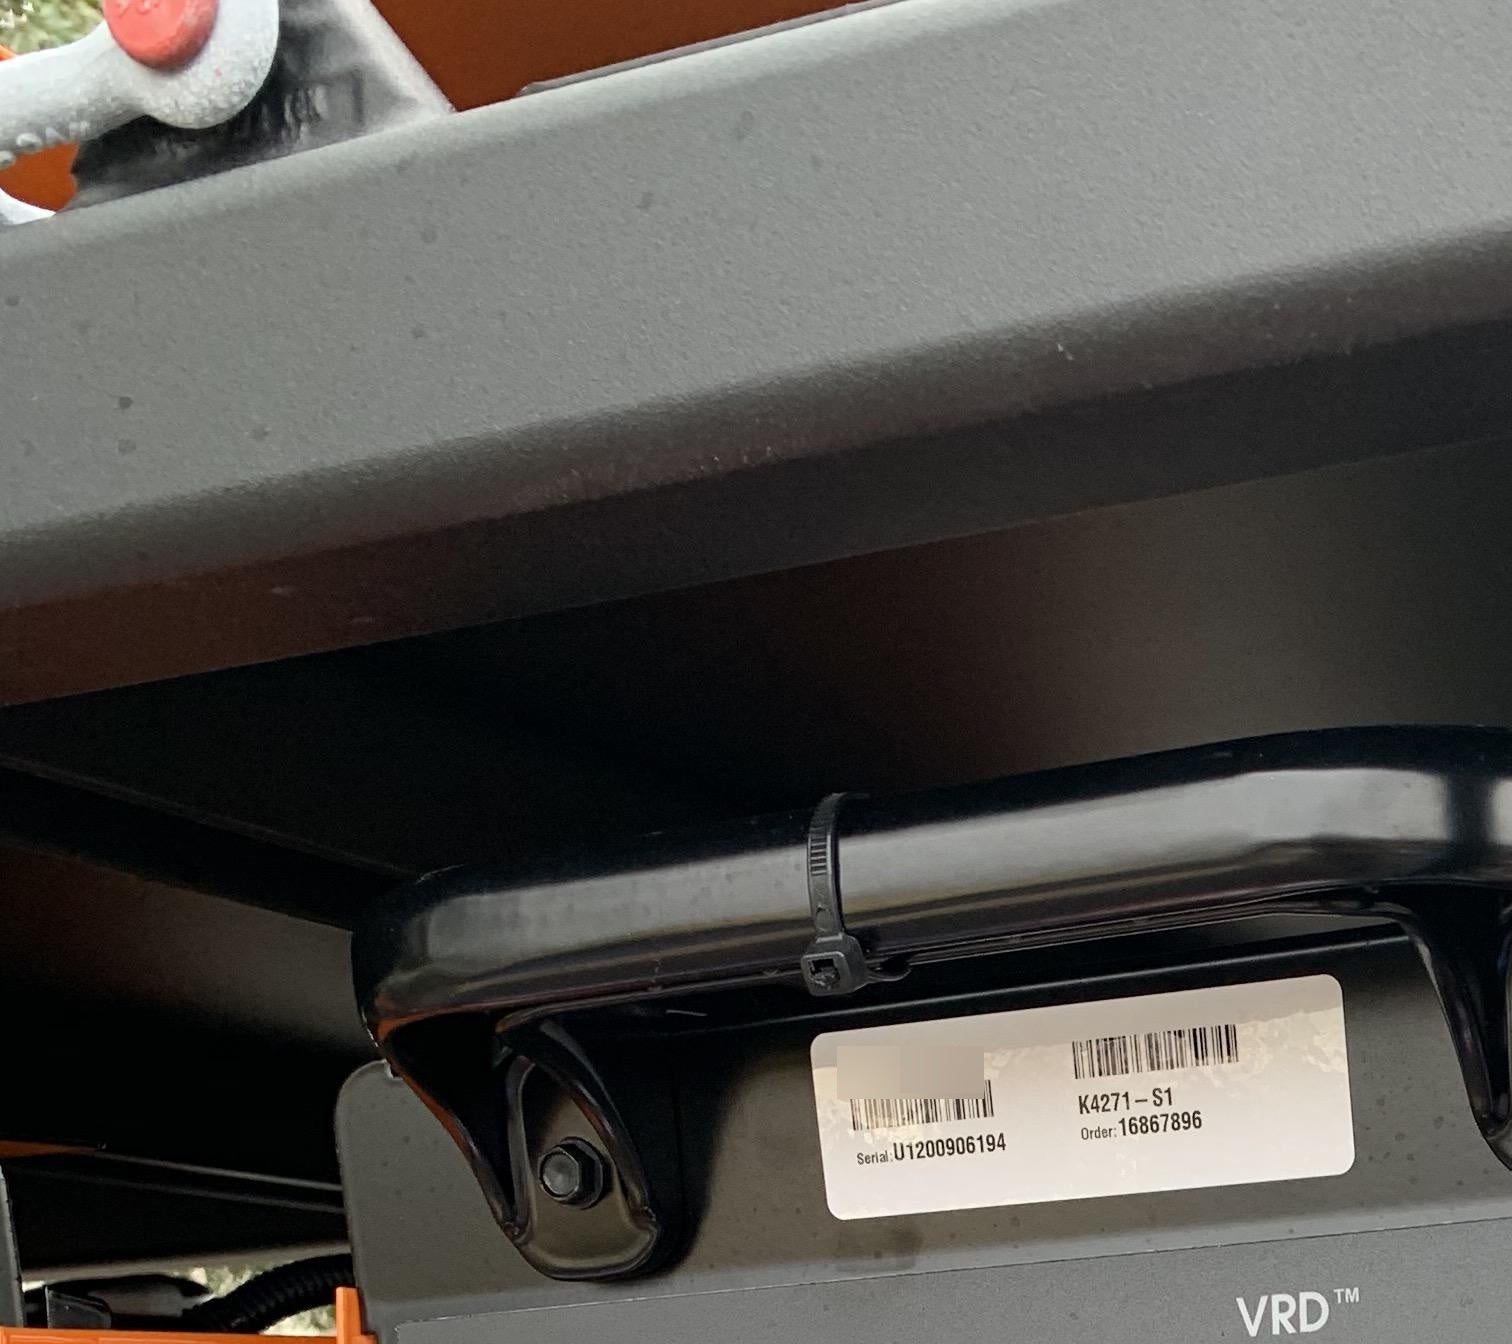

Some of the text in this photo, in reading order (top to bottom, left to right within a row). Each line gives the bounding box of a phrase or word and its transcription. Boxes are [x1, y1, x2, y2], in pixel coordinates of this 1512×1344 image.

[1080, 1110, 1203, 1141] Order: 16867896
[856, 1132, 1007, 1165] Serial: U1200906194
